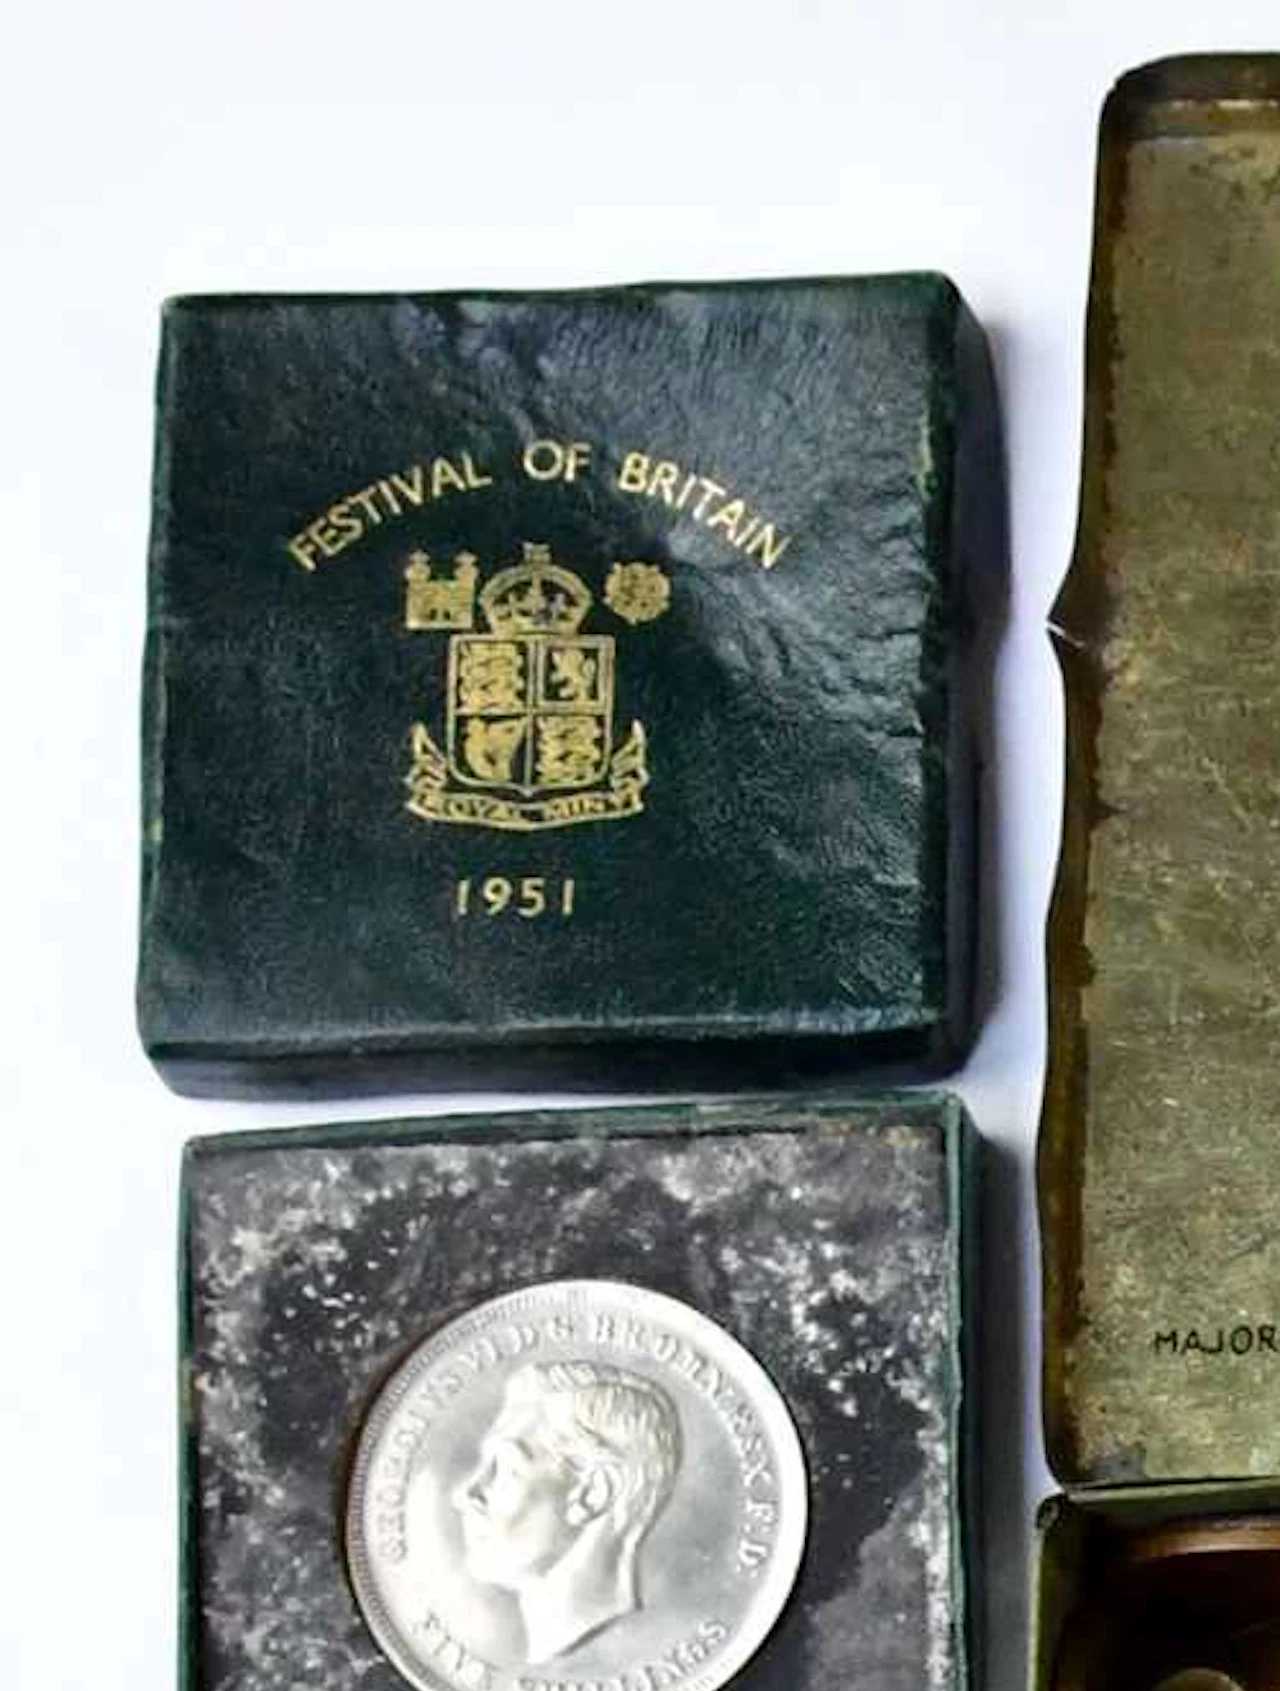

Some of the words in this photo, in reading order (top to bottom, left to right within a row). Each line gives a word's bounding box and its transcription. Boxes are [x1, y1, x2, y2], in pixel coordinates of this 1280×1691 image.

[286, 452, 493, 573] FESTIVAL
[522, 439, 592, 484] OF
[617, 450, 793, 570] BRITAIN
[455, 875, 576, 918] 1951
[1153, 1324, 1279, 1356] MAJOR
